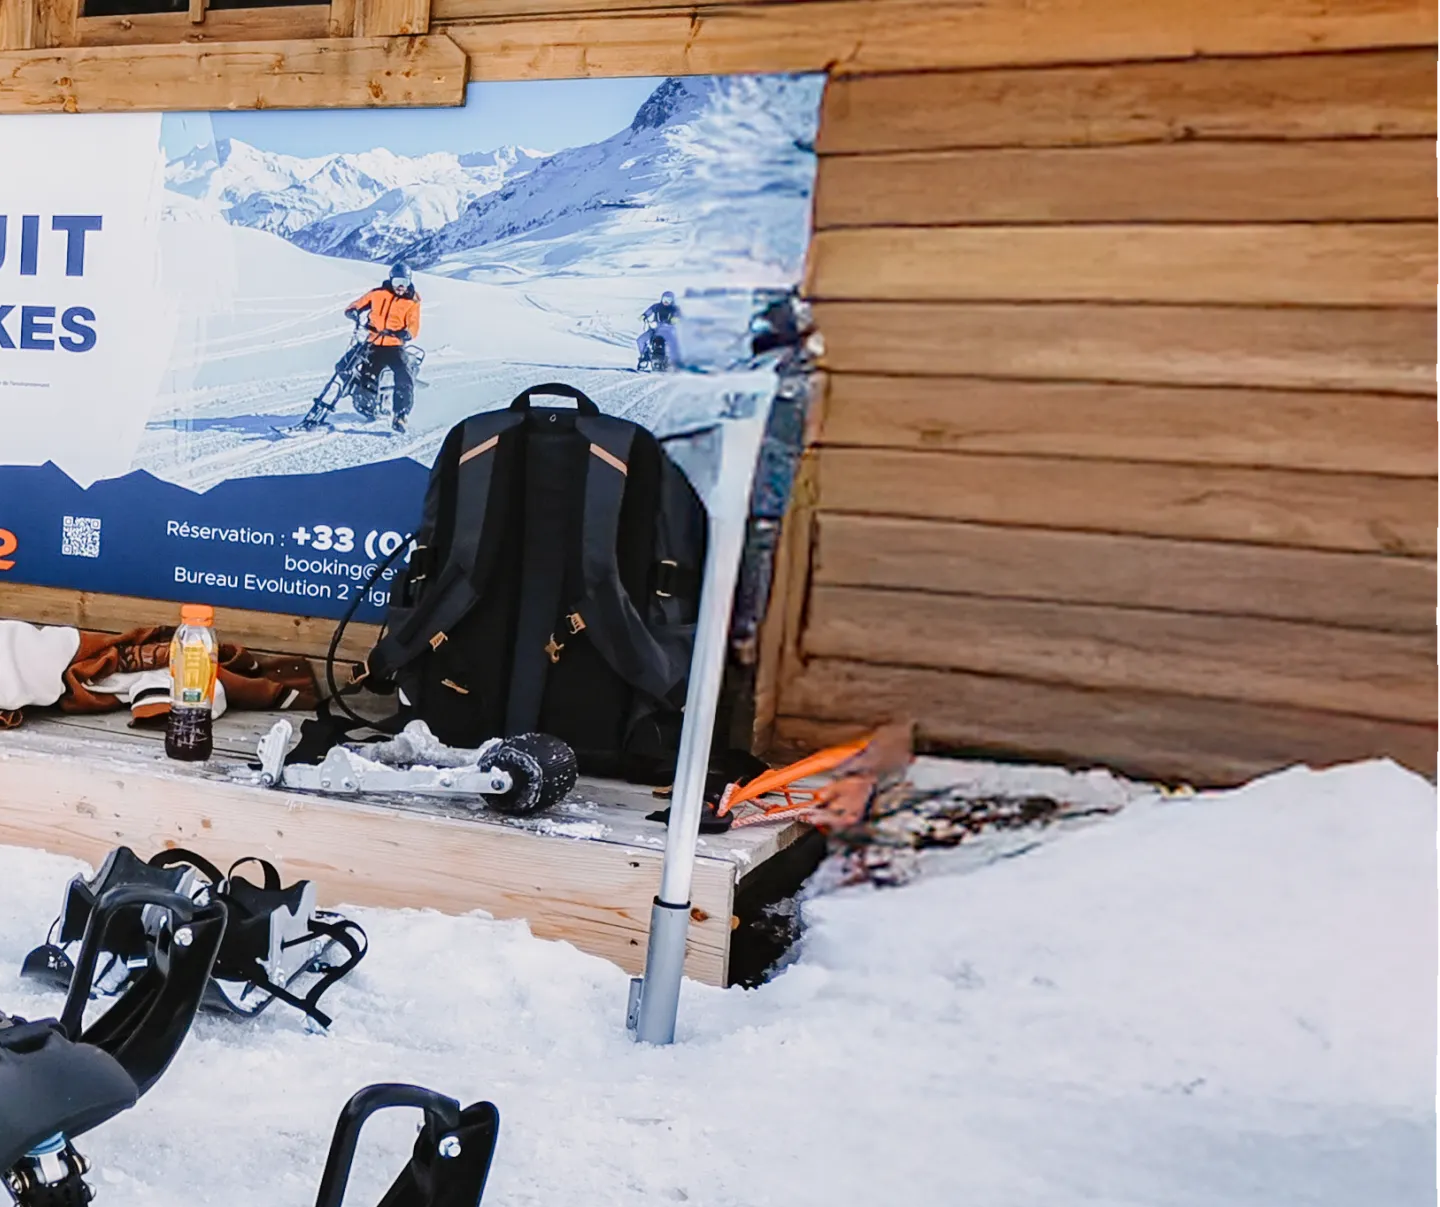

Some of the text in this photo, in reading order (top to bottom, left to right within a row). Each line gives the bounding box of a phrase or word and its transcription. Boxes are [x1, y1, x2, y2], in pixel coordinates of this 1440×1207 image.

[166, 520, 275, 546] Réservation
[292, 524, 355, 553] +33
[174, 566, 238, 589] Bureau
[244, 574, 331, 599] Evolution
[336, 584, 349, 600] 2
[284, 554, 398, 582] booking@e
